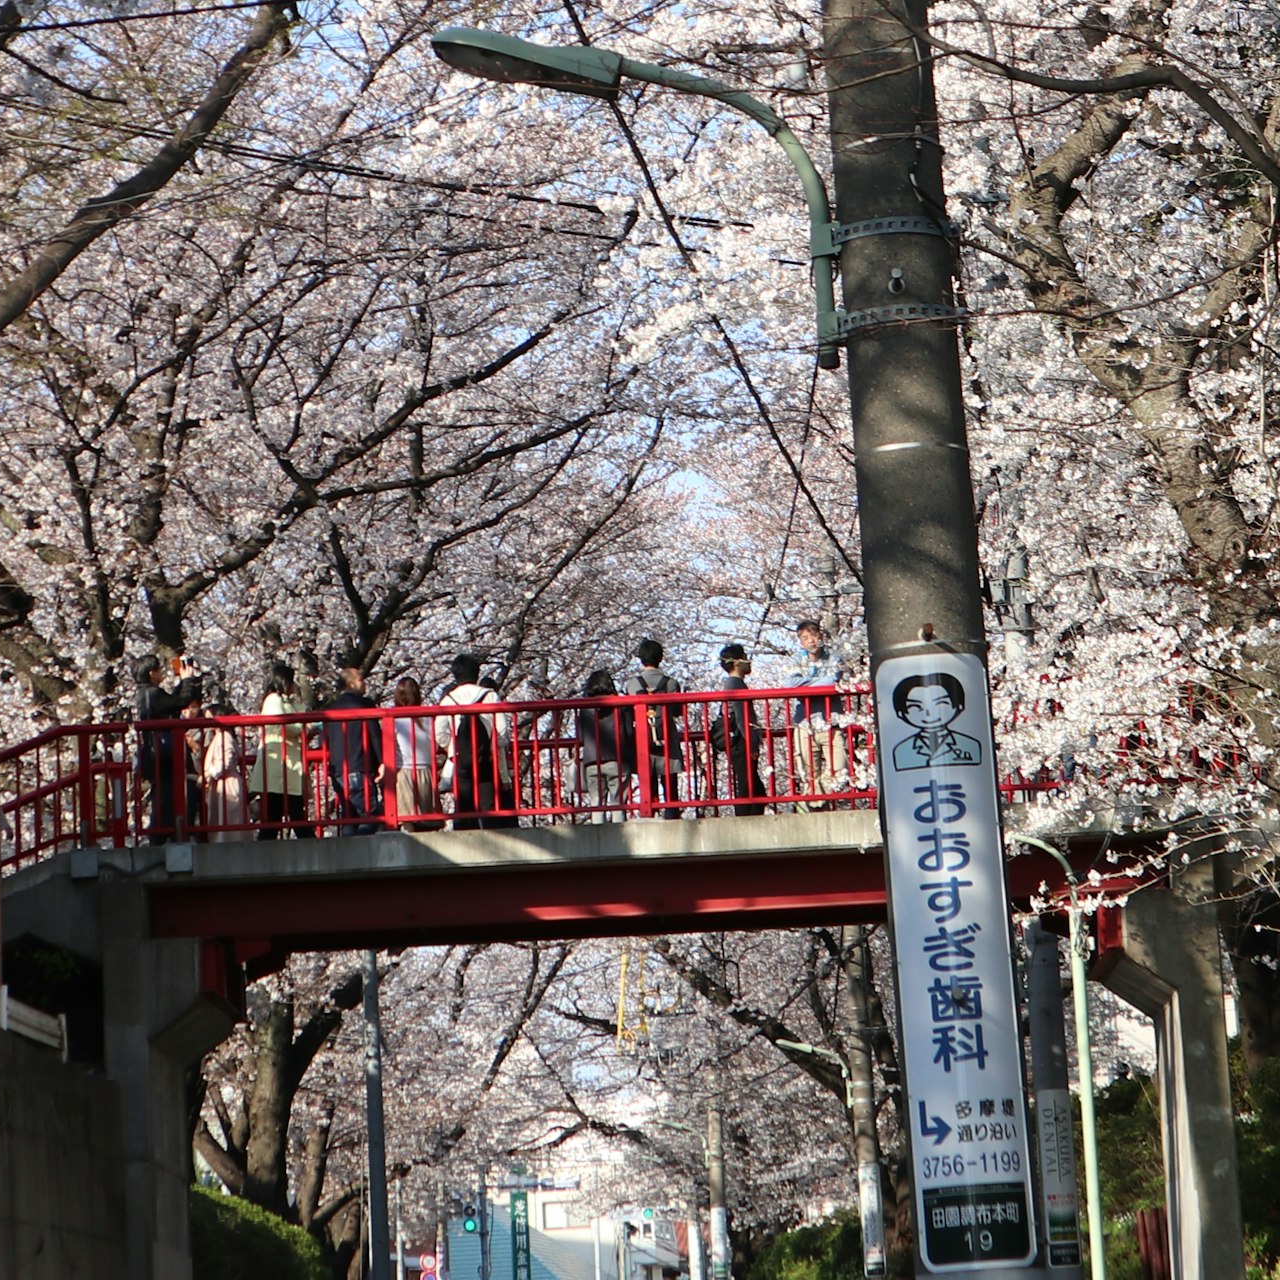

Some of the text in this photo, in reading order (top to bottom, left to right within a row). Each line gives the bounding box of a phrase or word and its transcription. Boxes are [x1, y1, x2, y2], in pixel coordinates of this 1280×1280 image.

[913, 779, 988, 1073] おおすぎ歯科
[955, 1099, 1015, 1119] 多摩堤
[958, 1123, 1017, 1143] 通り沿い
[1042, 1108, 1057, 1176] DENTAL
[1057, 1106, 1071, 1177] ASAKURA
[923, 1150, 1020, 1179] 3756-1199
[932, 1202, 1019, 1228] 田園調布本町
[964, 1230, 993, 1252] 19
